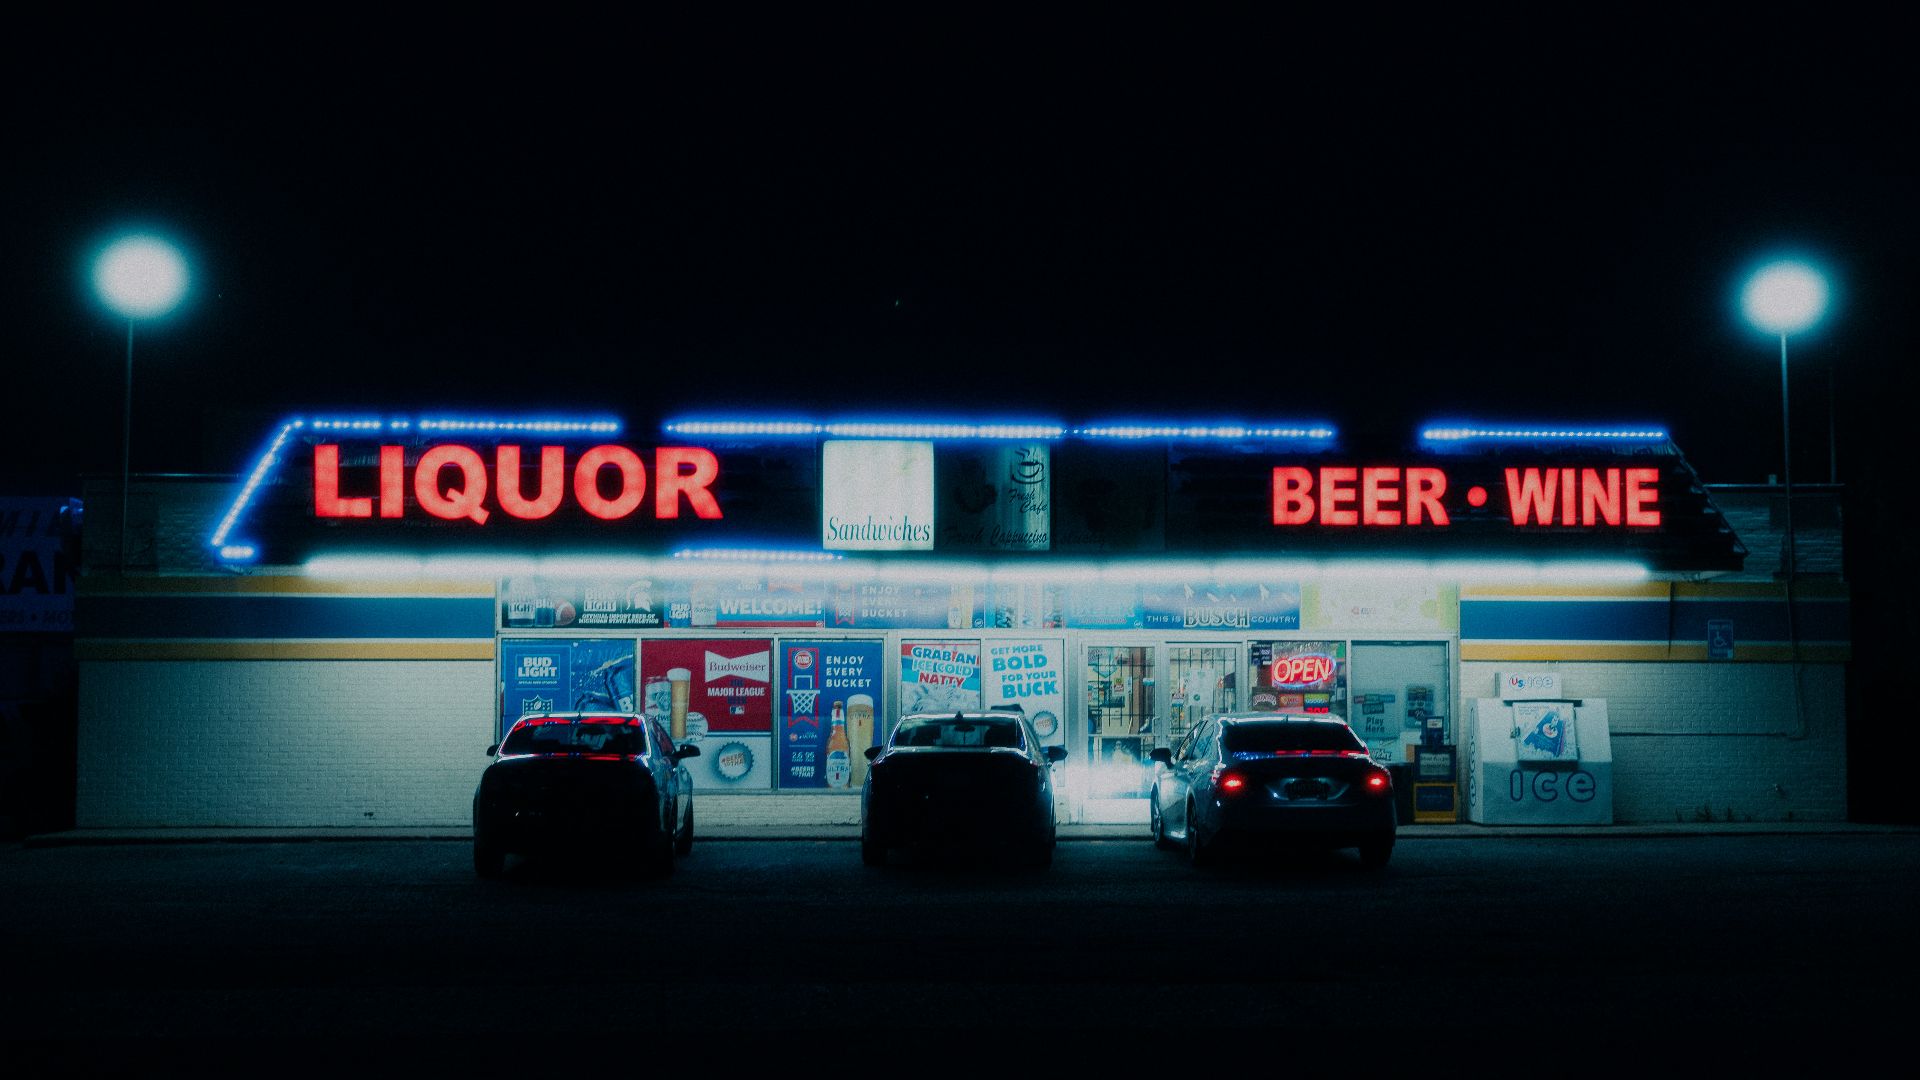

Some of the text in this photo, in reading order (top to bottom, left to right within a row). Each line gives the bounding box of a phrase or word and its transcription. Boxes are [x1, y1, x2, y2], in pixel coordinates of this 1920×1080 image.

[315, 444, 723, 525] LIQUOR
[1273, 466, 1661, 526] BEER WINE
[827, 515, 930, 542] Sandwiches
[862, 586, 900, 594] ENJOY
[719, 598, 822, 615] WELCOME!
[863, 597, 898, 606] EVERY
[862, 608, 907, 618] BUCKET
[1183, 606, 1250, 628] BUSCH
[1251, 615, 1296, 623] COUNTRY
[991, 643, 1043, 655] GET MORE
[523, 656, 552, 667] BUD
[826, 655, 865, 665] ENJOY
[912, 646, 977, 665] GRAB AN
[709, 661, 766, 672] Budweiser
[913, 658, 973, 676] ICE COLD
[992, 654, 1048, 672] BOLD
[517, 666, 558, 678] LIGHT
[826, 667, 863, 676] EVERY
[1273, 658, 1330, 682] OPEN
[826, 678, 872, 688] BUCKET
[919, 672, 965, 688] NATTY
[1002, 671, 1057, 683] FOR YOUR
[707, 687, 765, 697] MAJOR LEAGUE
[1366, 717, 1384, 726] Play
[1366, 725, 1385, 733] Here
